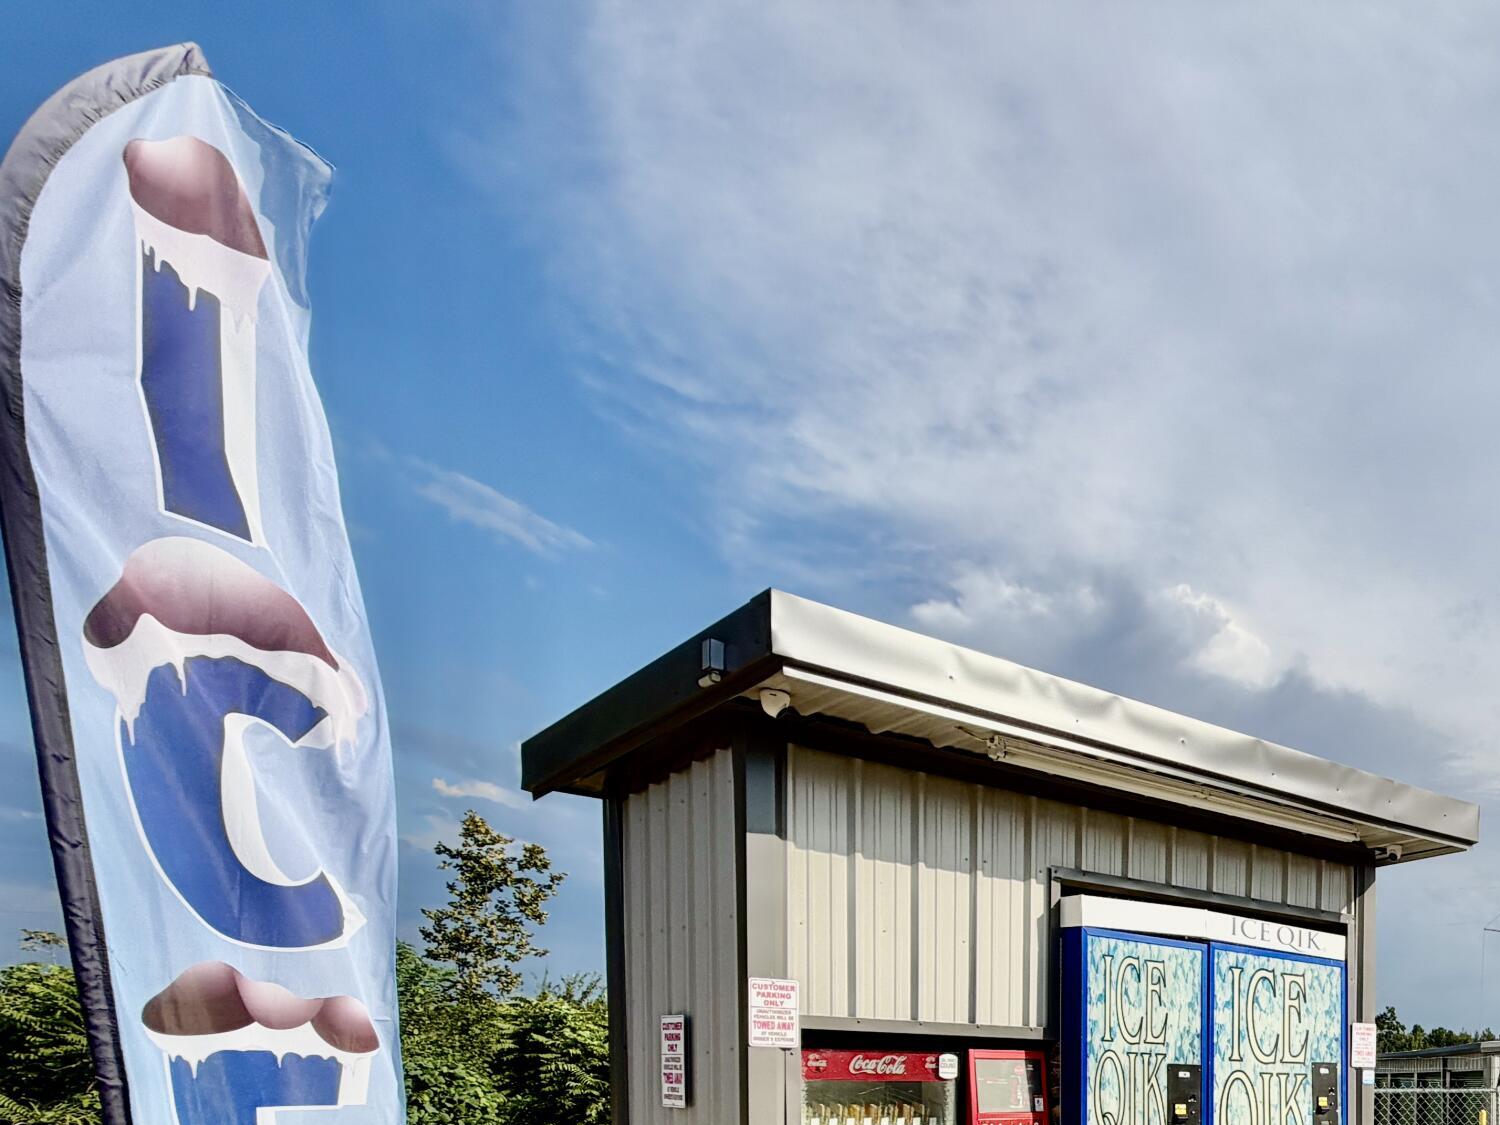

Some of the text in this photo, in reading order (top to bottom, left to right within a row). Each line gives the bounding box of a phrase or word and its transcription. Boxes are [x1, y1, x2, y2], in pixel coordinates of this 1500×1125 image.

[1231, 916, 1321, 952] ICE QIK
[752, 983, 796, 992] CUSTOMER
[756, 991, 791, 1000] PARKING
[1101, 954, 1168, 1045] ICE
[753, 1020, 795, 1031] TOWED AWAY
[1229, 966, 1309, 1065] ICE
[849, 1054, 908, 1075] Coca-Cola
